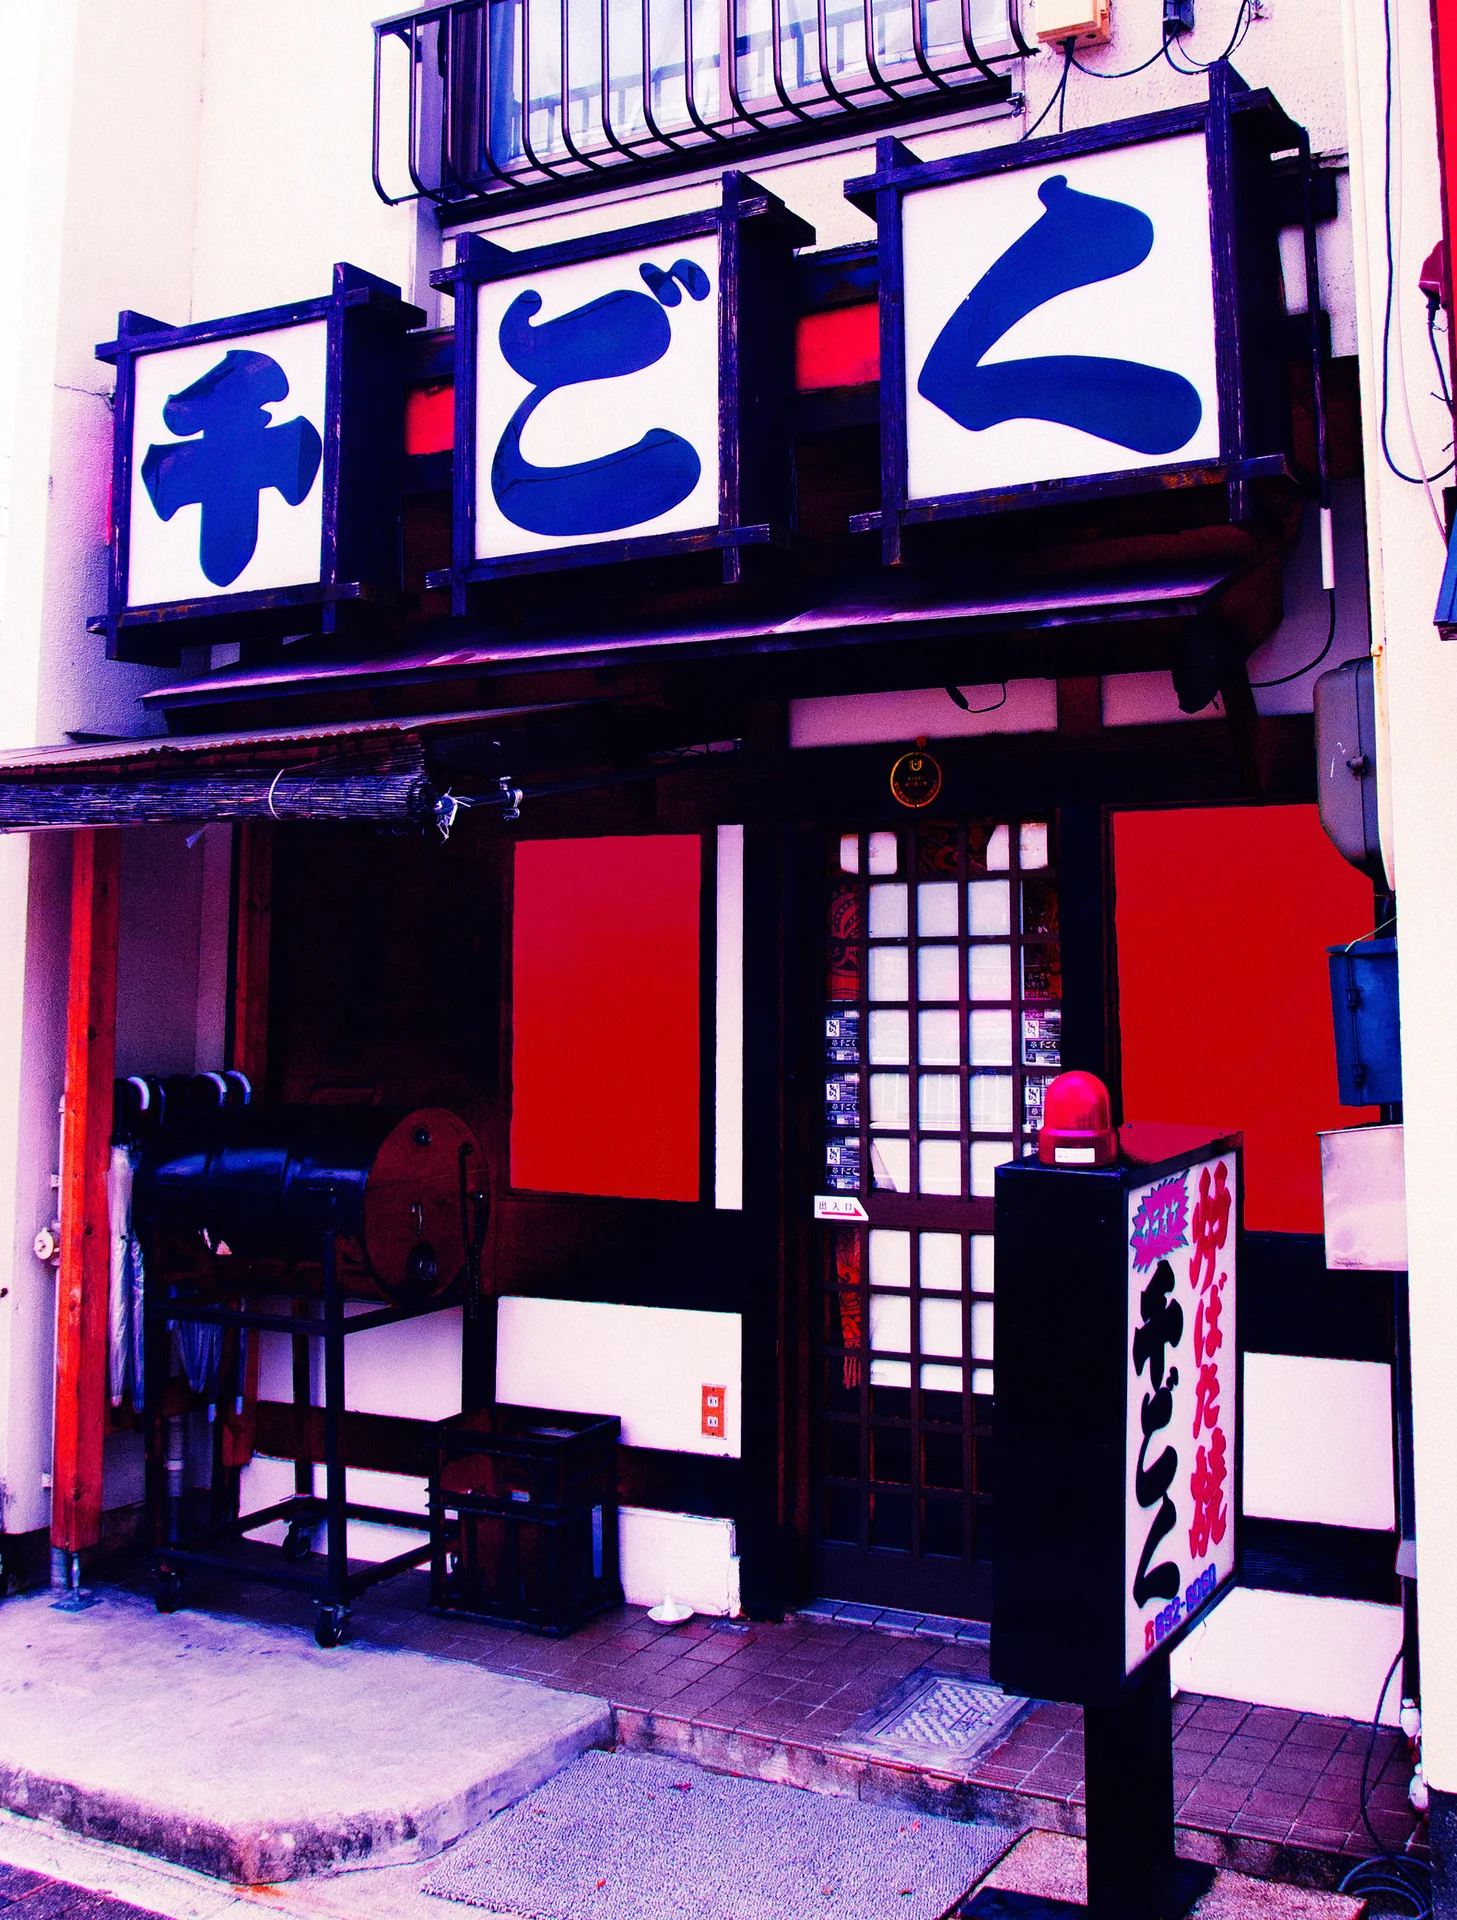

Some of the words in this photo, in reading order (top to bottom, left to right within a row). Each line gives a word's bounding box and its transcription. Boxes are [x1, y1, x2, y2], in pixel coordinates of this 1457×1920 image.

[141, 174, 1203, 586] 千ごく
[818, 1201, 852, 1211] 出入口
[1141, 1200, 1179, 1244] カラオケ
[1189, 1160, 1231, 1559] 炉ばた焼
[1132, 1259, 1183, 1609] 千ごく
